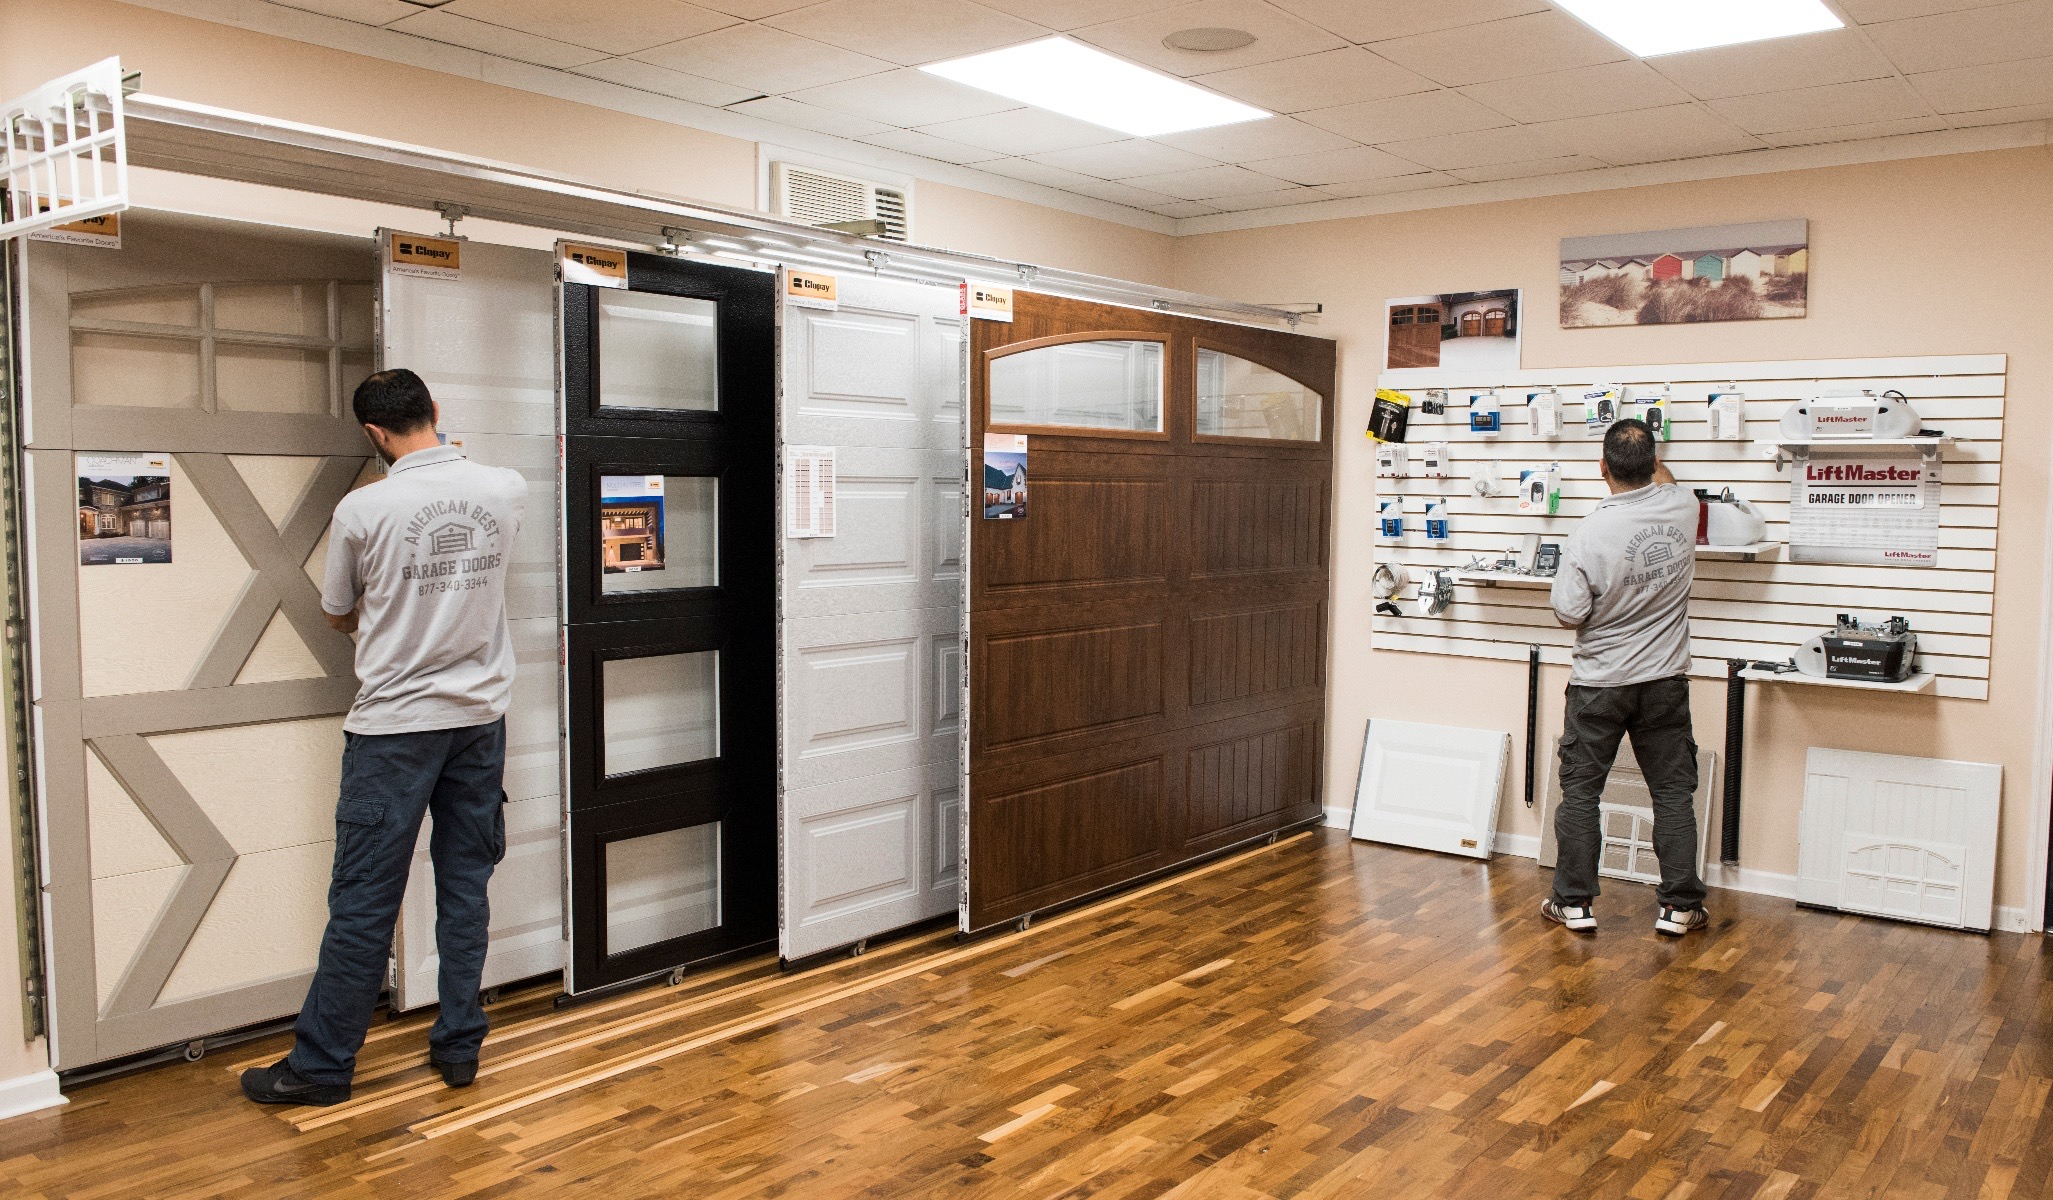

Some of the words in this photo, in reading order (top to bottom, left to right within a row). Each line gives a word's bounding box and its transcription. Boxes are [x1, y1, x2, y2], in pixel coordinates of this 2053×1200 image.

[415, 245, 451, 260] Clopay
[586, 255, 618, 270] Clopay
[804, 280, 830, 292] Clopay
[985, 293, 1007, 305] Clopay
[1806, 464, 1921, 481] LiftMaster
[1808, 493, 1846, 504] GARAGE
[1848, 493, 1875, 505] DOOR
[1877, 493, 1916, 505] OPENER
[404, 499, 468, 547] AMERICAN
[470, 505, 500, 538] BEST
[1624, 524, 1664, 562] AMERICAN
[1666, 525, 1688, 547] BEST
[1884, 551, 1932, 559] LiftMaster
[402, 559, 457, 580] GARAGE
[461, 552, 502, 574] DOORS
[1623, 567, 1665, 586] GARAGE
[418, 575, 488, 597] 877-340-3344
[1831, 655, 1882, 666] LiftMaster
